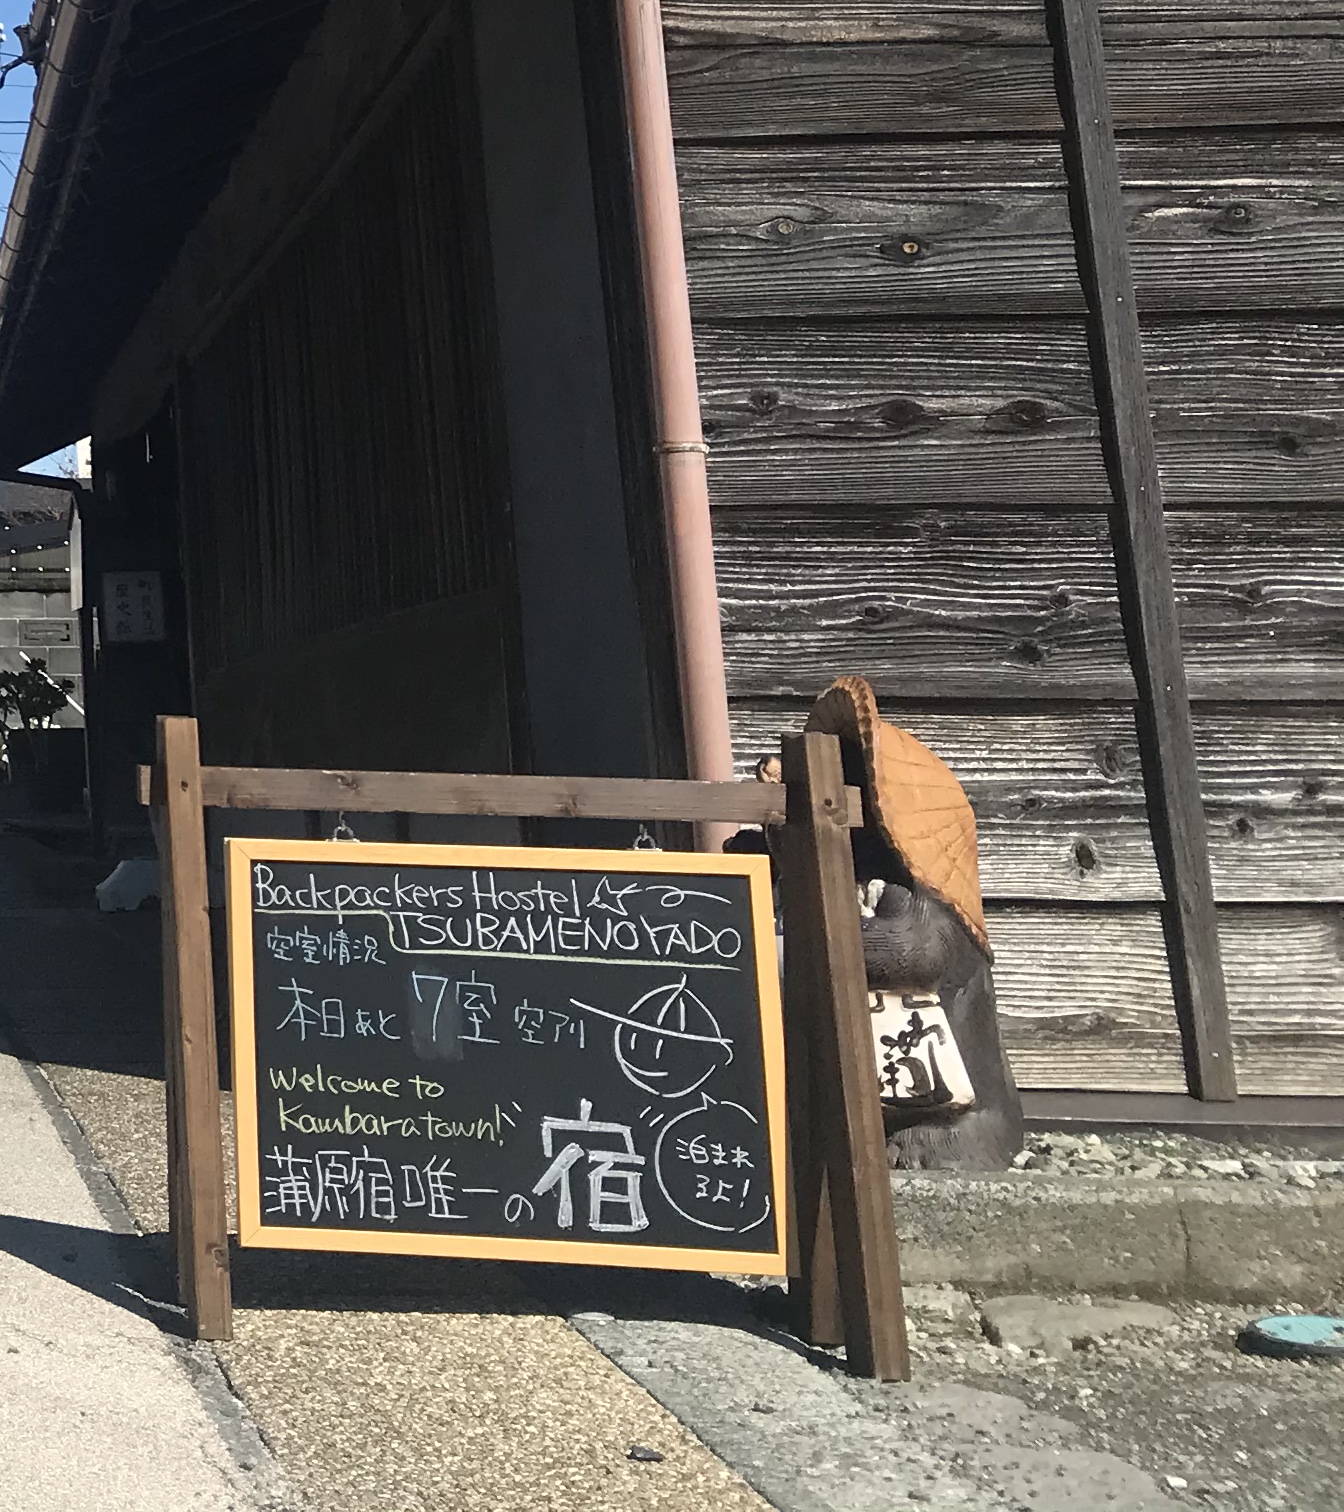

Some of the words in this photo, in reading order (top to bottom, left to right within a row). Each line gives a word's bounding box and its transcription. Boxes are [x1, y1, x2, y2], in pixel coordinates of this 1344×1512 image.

[253, 862, 464, 925] Backpackers
[472, 870, 581, 917] Hostel
[389, 911, 742, 958] TSUBAMENOYADO
[269, 1063, 400, 1098] Welcome
[408, 1074, 445, 1100] to
[675, 1133, 755, 1169] 泊まれ
